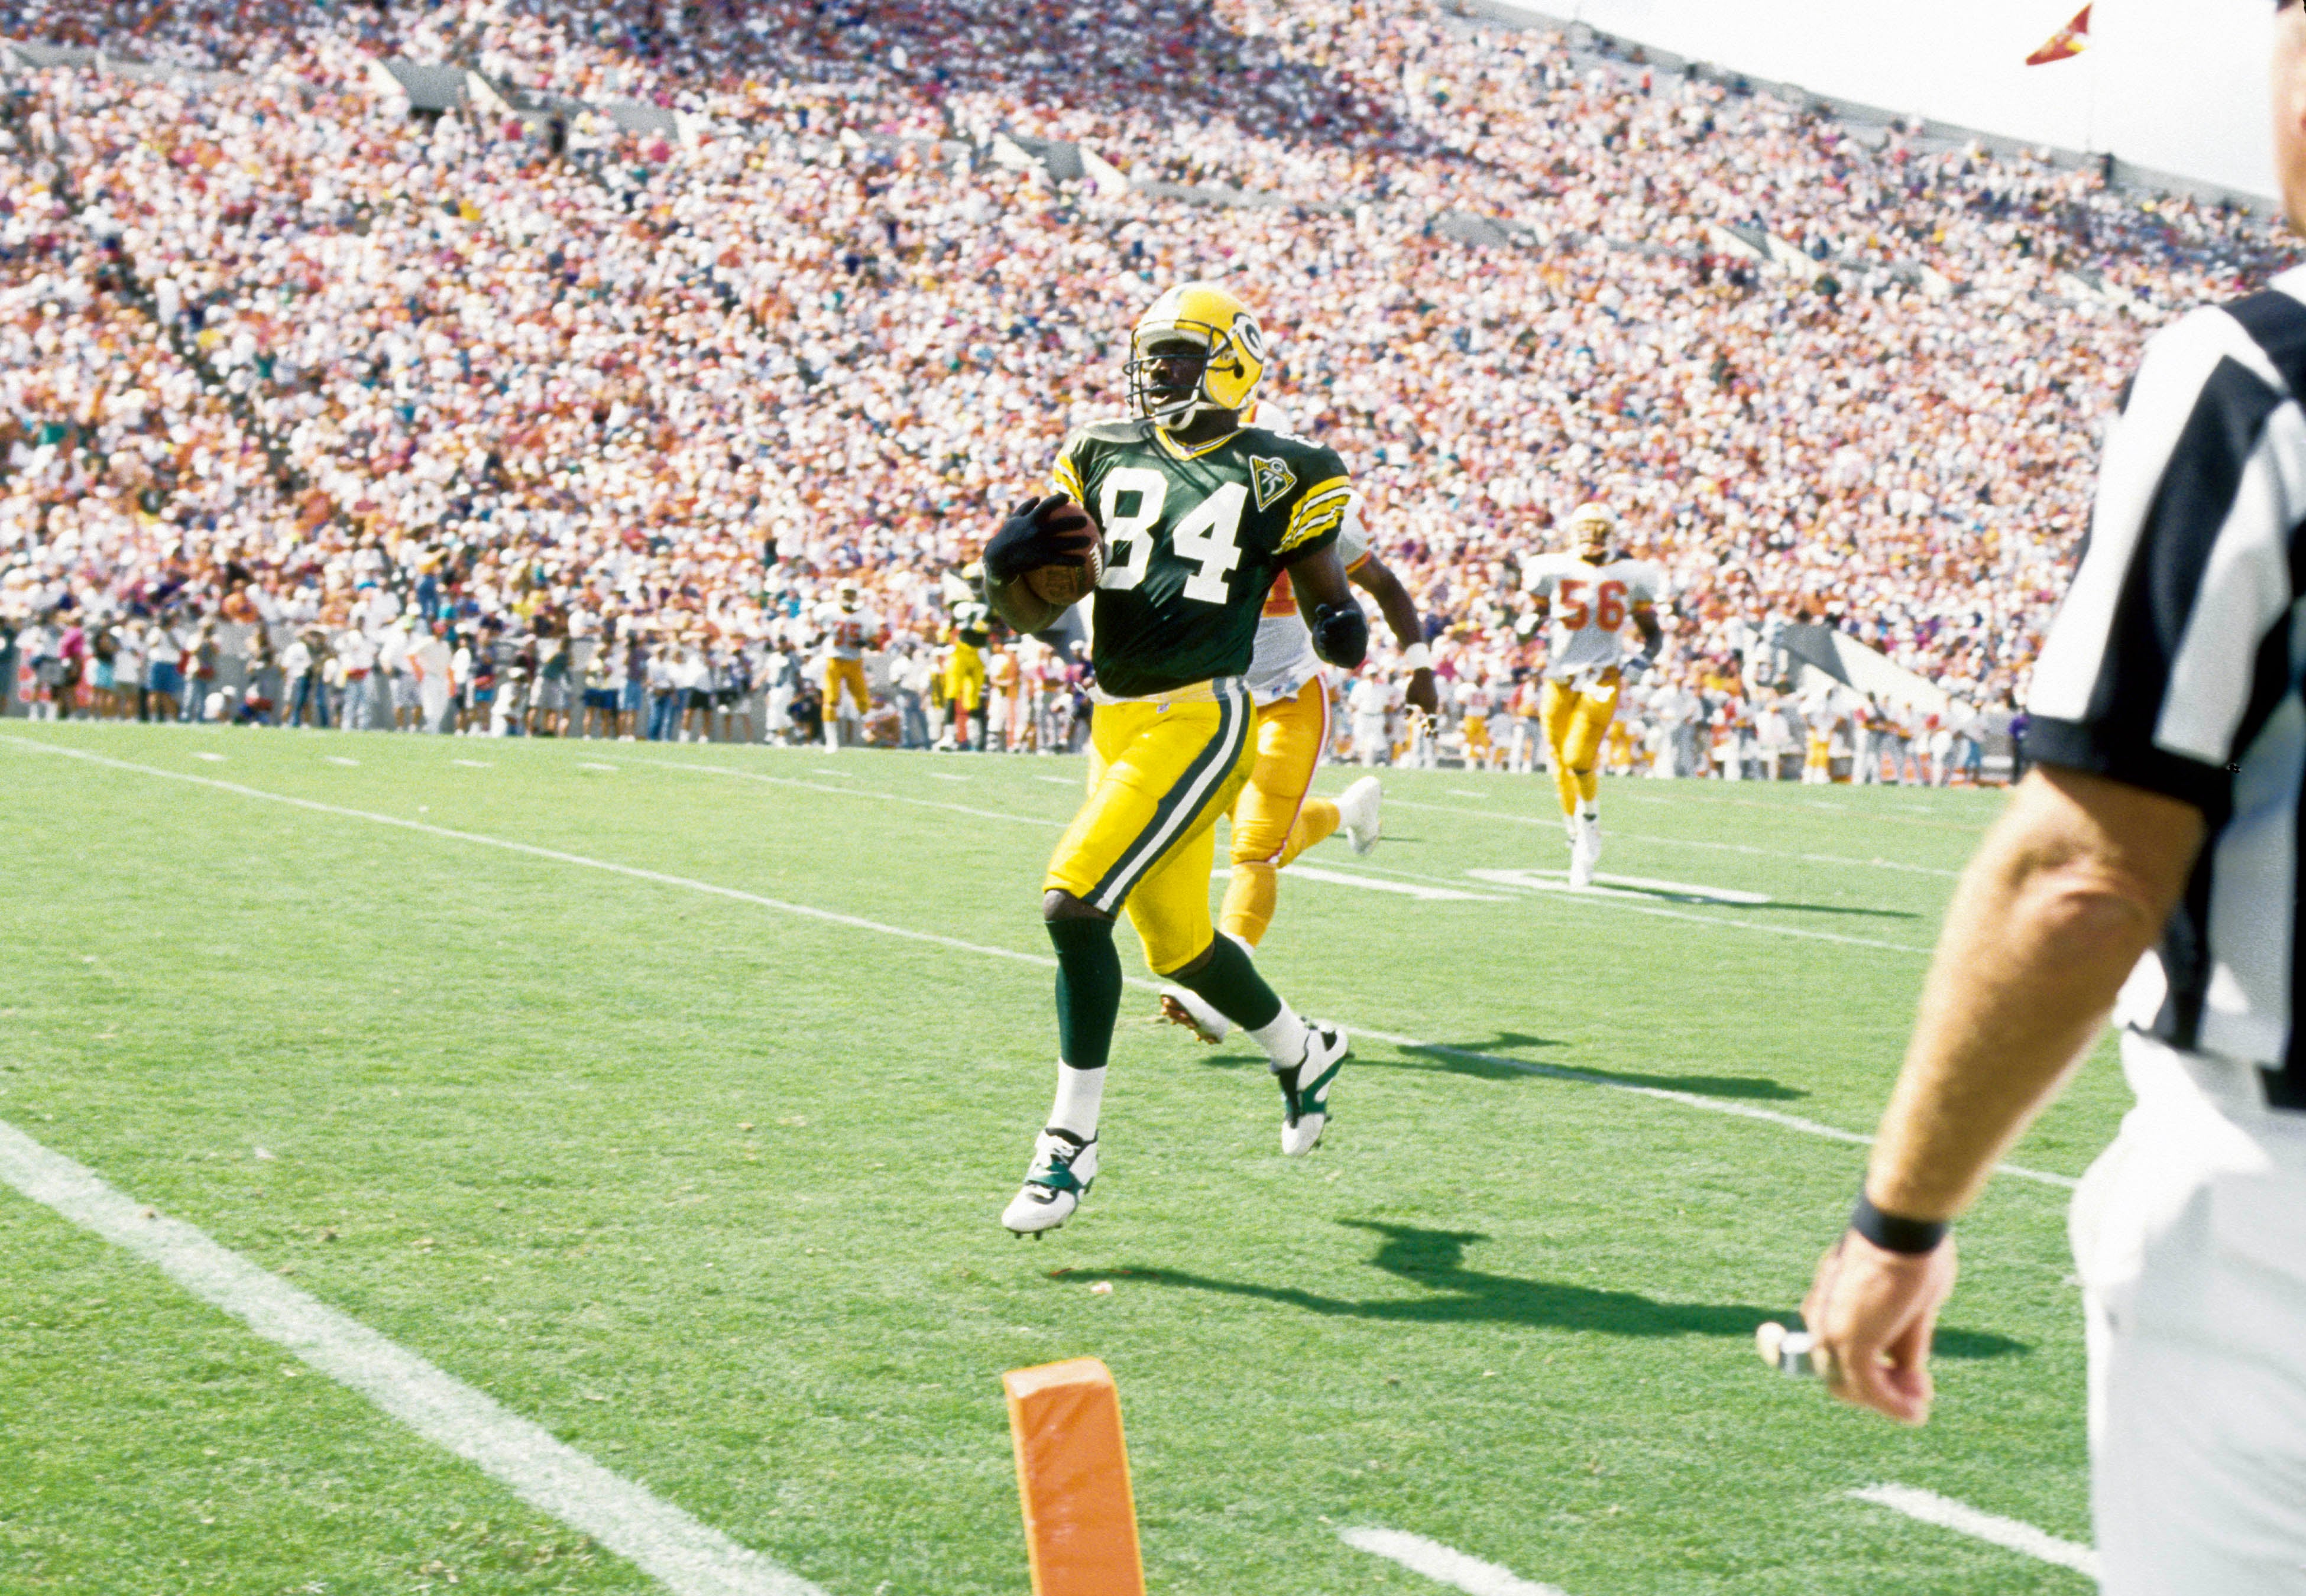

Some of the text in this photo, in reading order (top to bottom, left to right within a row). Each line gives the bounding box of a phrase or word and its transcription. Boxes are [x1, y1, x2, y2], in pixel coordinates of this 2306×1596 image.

[1261, 471, 1283, 497] 75
[1098, 466, 1249, 605] 84
[1559, 579, 1627, 632] 56
